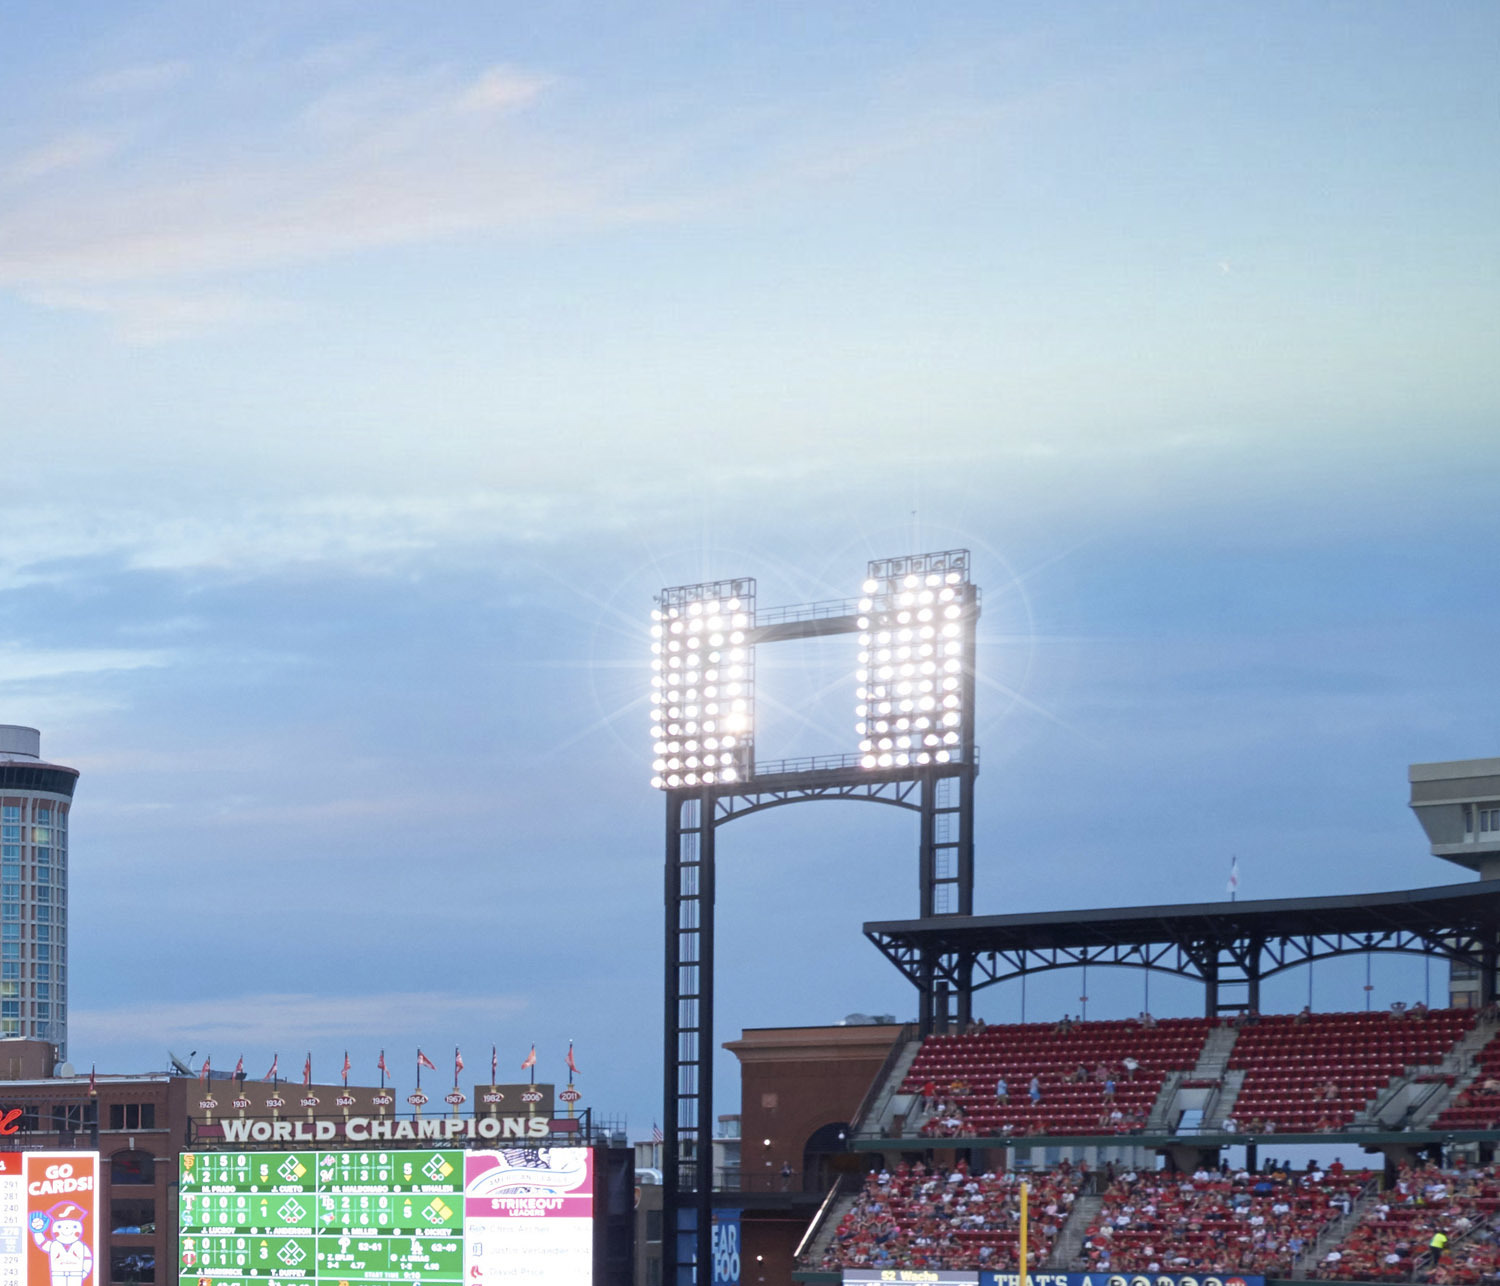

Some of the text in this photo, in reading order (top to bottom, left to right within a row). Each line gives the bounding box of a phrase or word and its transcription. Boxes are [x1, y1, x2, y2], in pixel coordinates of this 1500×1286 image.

[408, 1096, 425, 1104] 1964
[220, 1117, 550, 1142] WORLD CHAMPIONS
[45, 1164, 73, 1179] GO
[28, 1176, 93, 1196] CARDS!
[491, 1198, 564, 1209] STRIKEOUT
